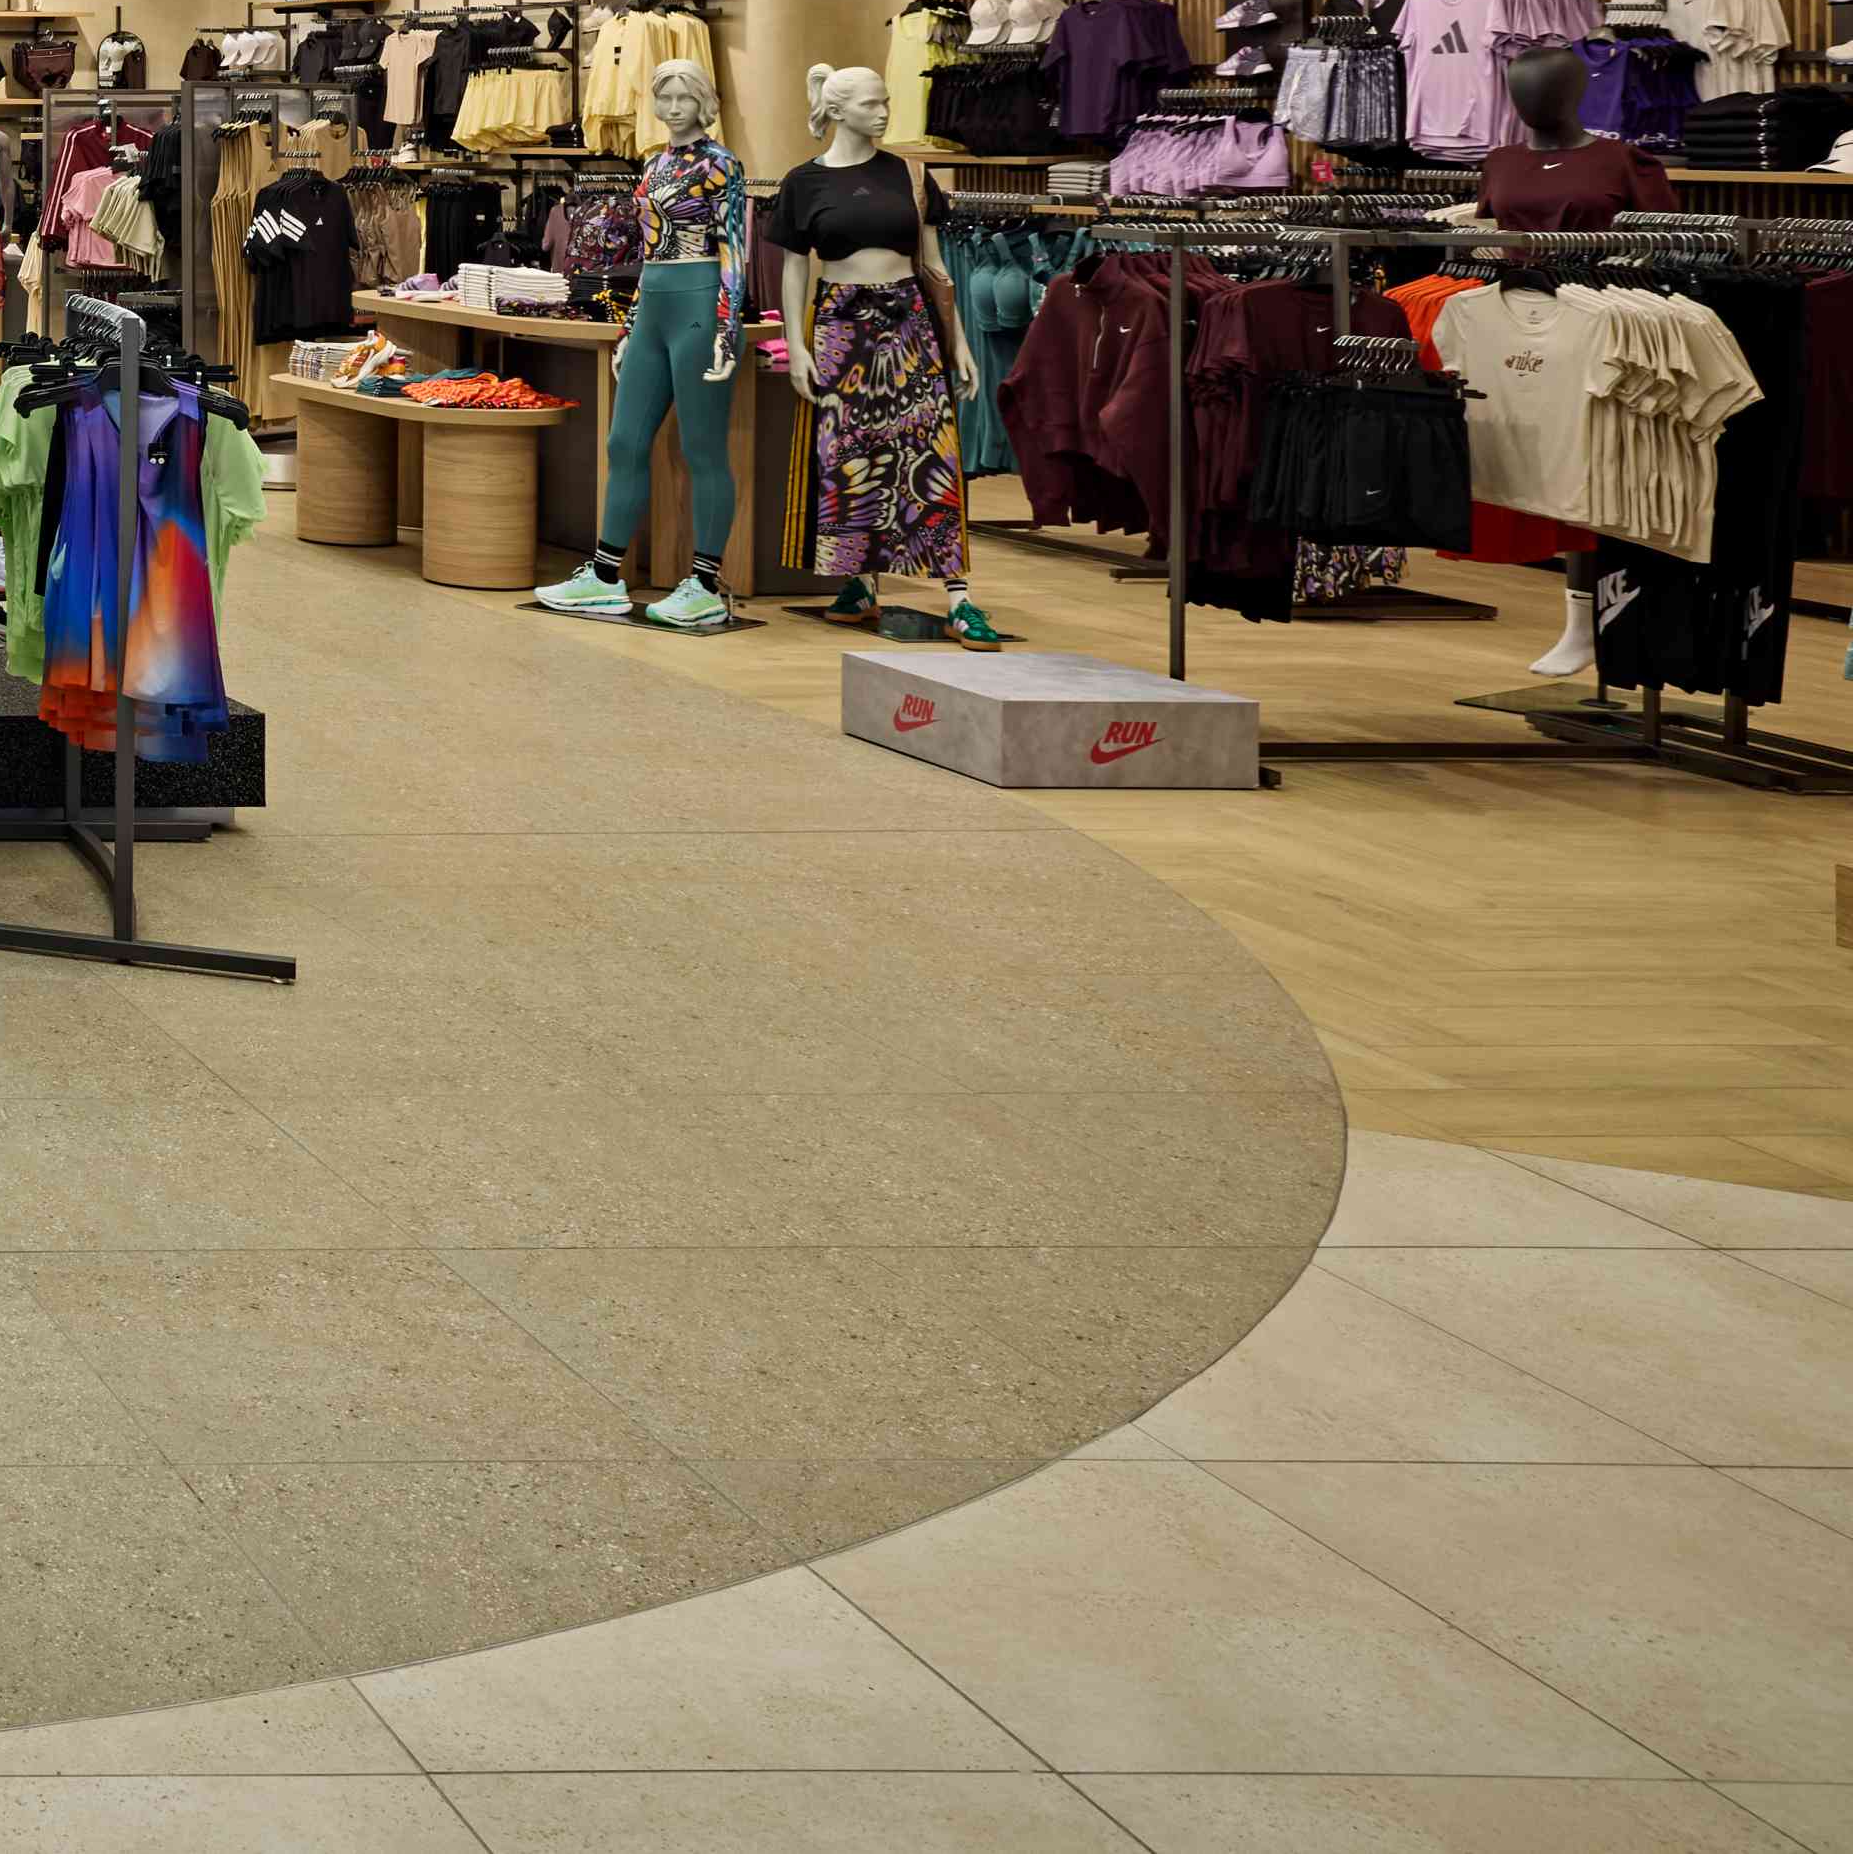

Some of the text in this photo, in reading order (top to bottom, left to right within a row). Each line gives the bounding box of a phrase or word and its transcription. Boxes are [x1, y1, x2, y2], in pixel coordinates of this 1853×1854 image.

[1505, 350, 1544, 373] nike
[1597, 569, 1628, 611] IKE
[902, 694, 935, 721] RUN
[1104, 721, 1159, 746] RUN
